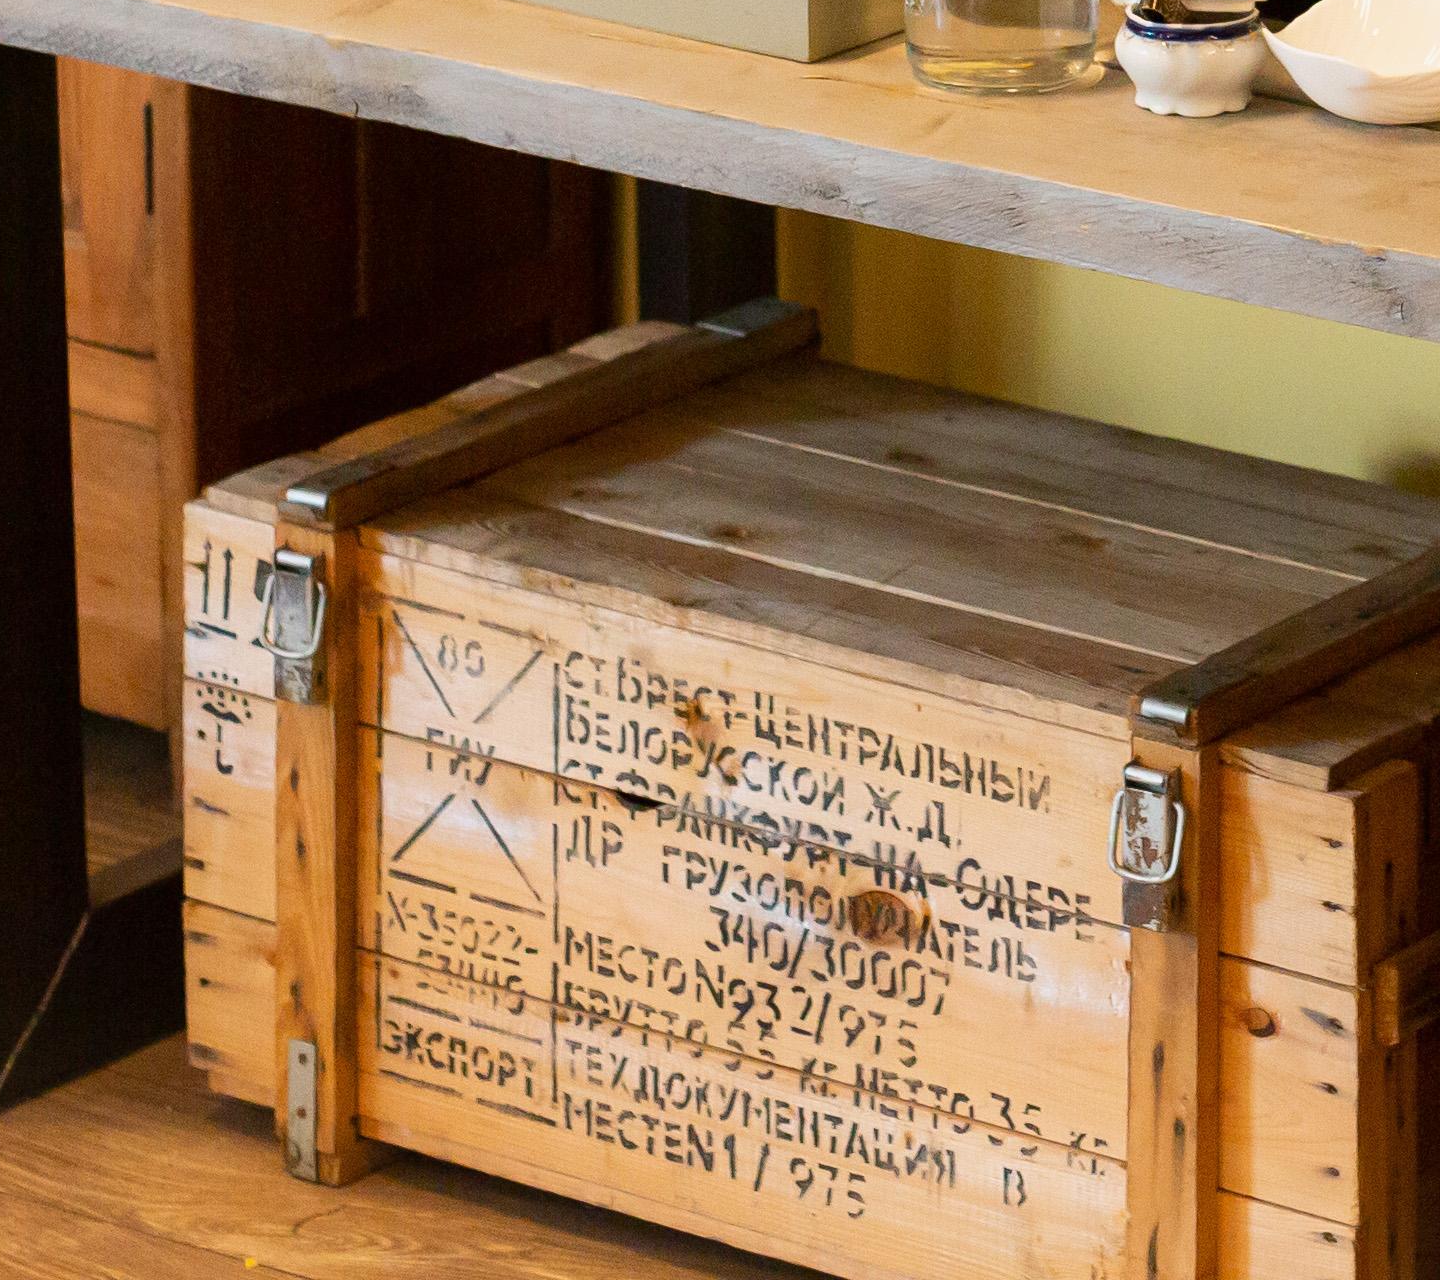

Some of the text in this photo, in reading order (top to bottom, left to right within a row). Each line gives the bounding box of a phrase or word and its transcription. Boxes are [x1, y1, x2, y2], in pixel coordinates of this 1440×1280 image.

[564, 693, 846, 816] БЕЛОРУССКОЙ
[705, 904, 952, 1016] 340/30007
[382, 1019, 536, 1098] ЭКСПОРТ
